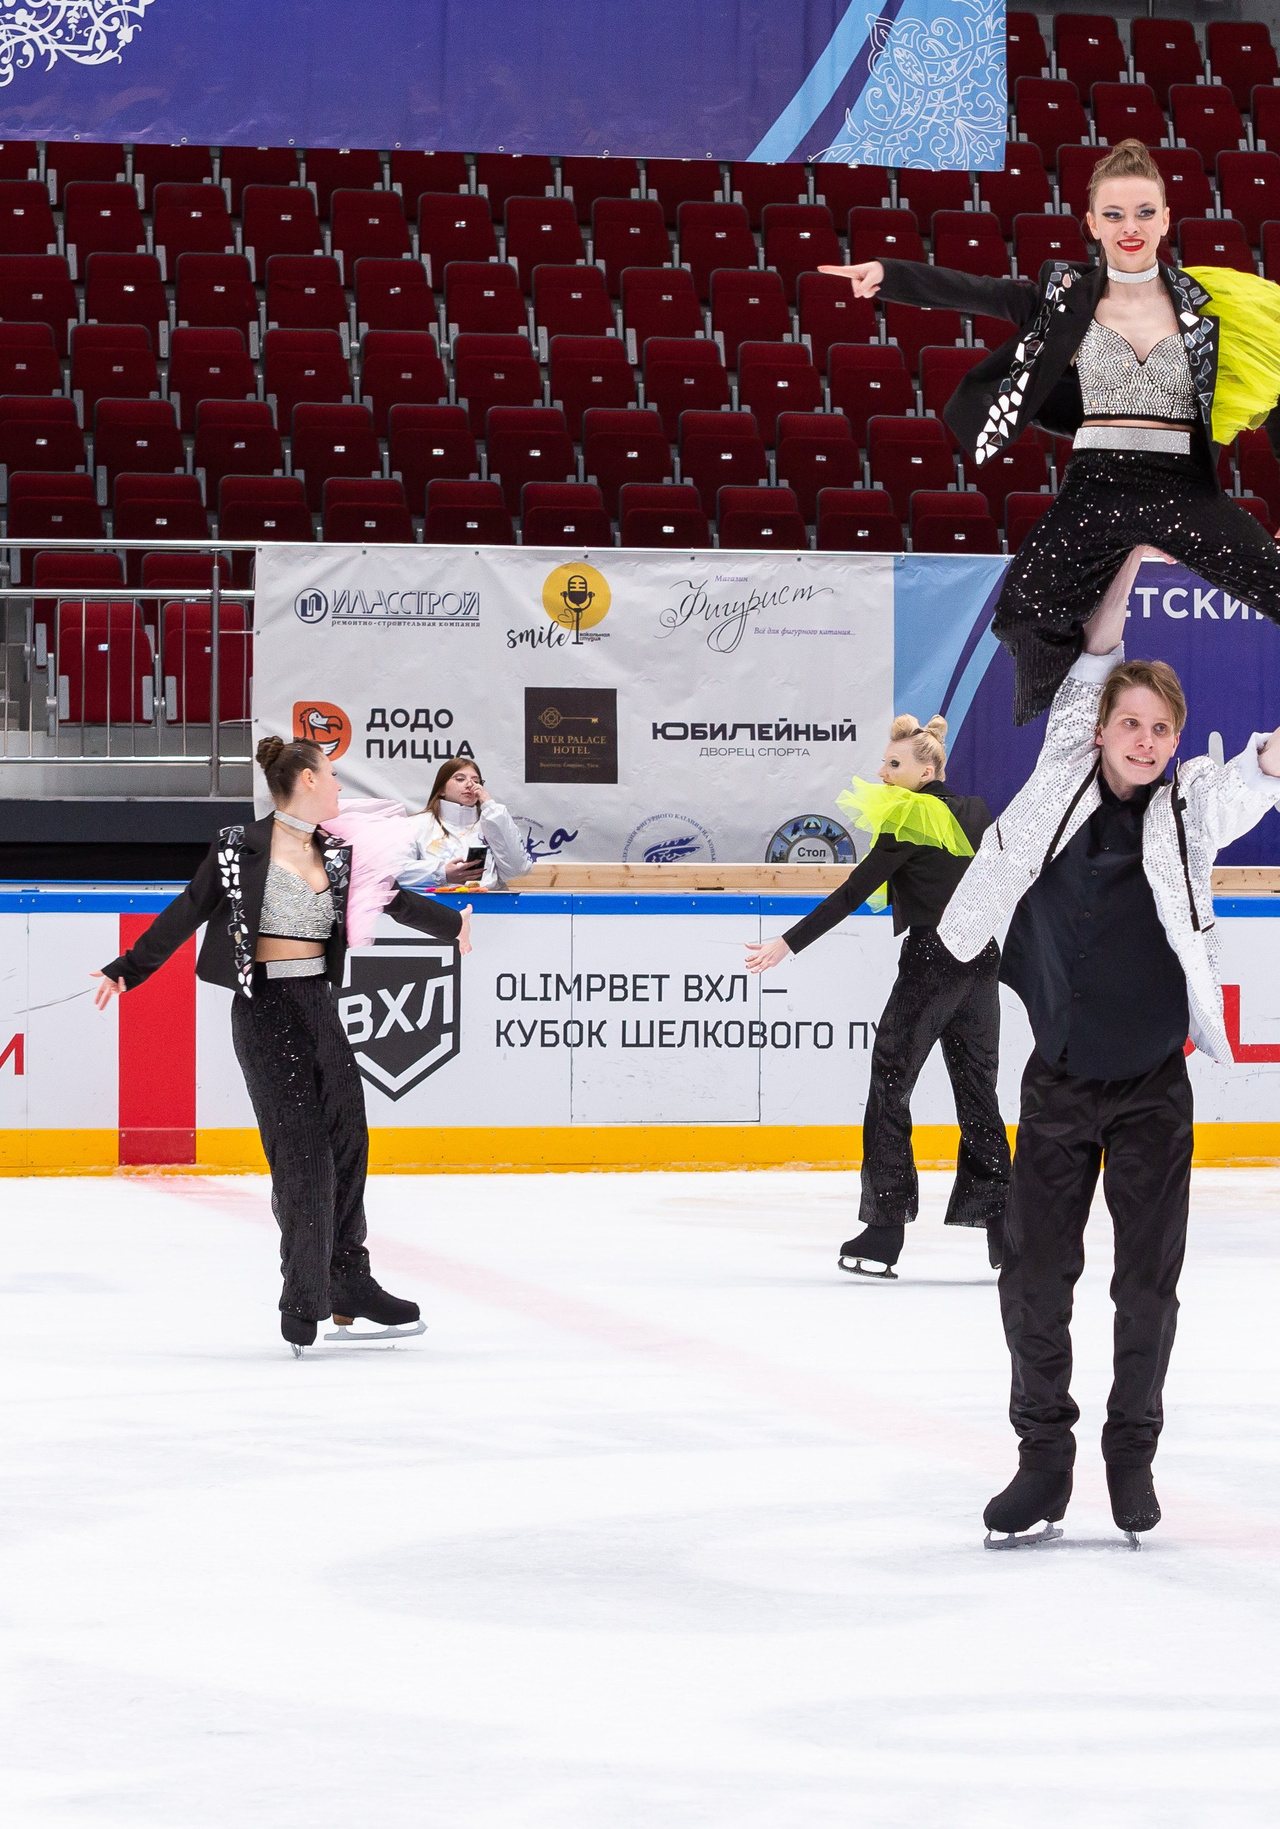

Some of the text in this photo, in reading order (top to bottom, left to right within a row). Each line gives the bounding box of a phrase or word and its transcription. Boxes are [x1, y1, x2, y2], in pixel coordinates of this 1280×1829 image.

[715, 575, 748, 583] Магазин
[332, 590, 480, 616] ИЛАССТРОЙ
[331, 619, 437, 628] ремонтно-строительная
[654, 580, 834, 653] Фигурист
[507, 620, 568, 649] smile
[781, 626, 817, 637] фигурного
[366, 708, 454, 733] ДОДО
[652, 717, 857, 742] ЮБИЛЕЙНЫЙ
[366, 739, 475, 763] ПИЦЦА
[533, 735, 607, 745] RIVER PALACE
[553, 745, 590, 755] HOTEL
[699, 747, 811, 758] ДВОРЕЦ СПОРТА
[797, 846, 826, 858] Стоп
[496, 973, 670, 1002] OLIMPBET
[684, 974, 747, 1003] ВХЛ
[338, 974, 454, 1045] ВХЛ
[496, 1019, 607, 1048] КУБОК
[622, 1020, 834, 1050] ШЕЛКОВОГО
